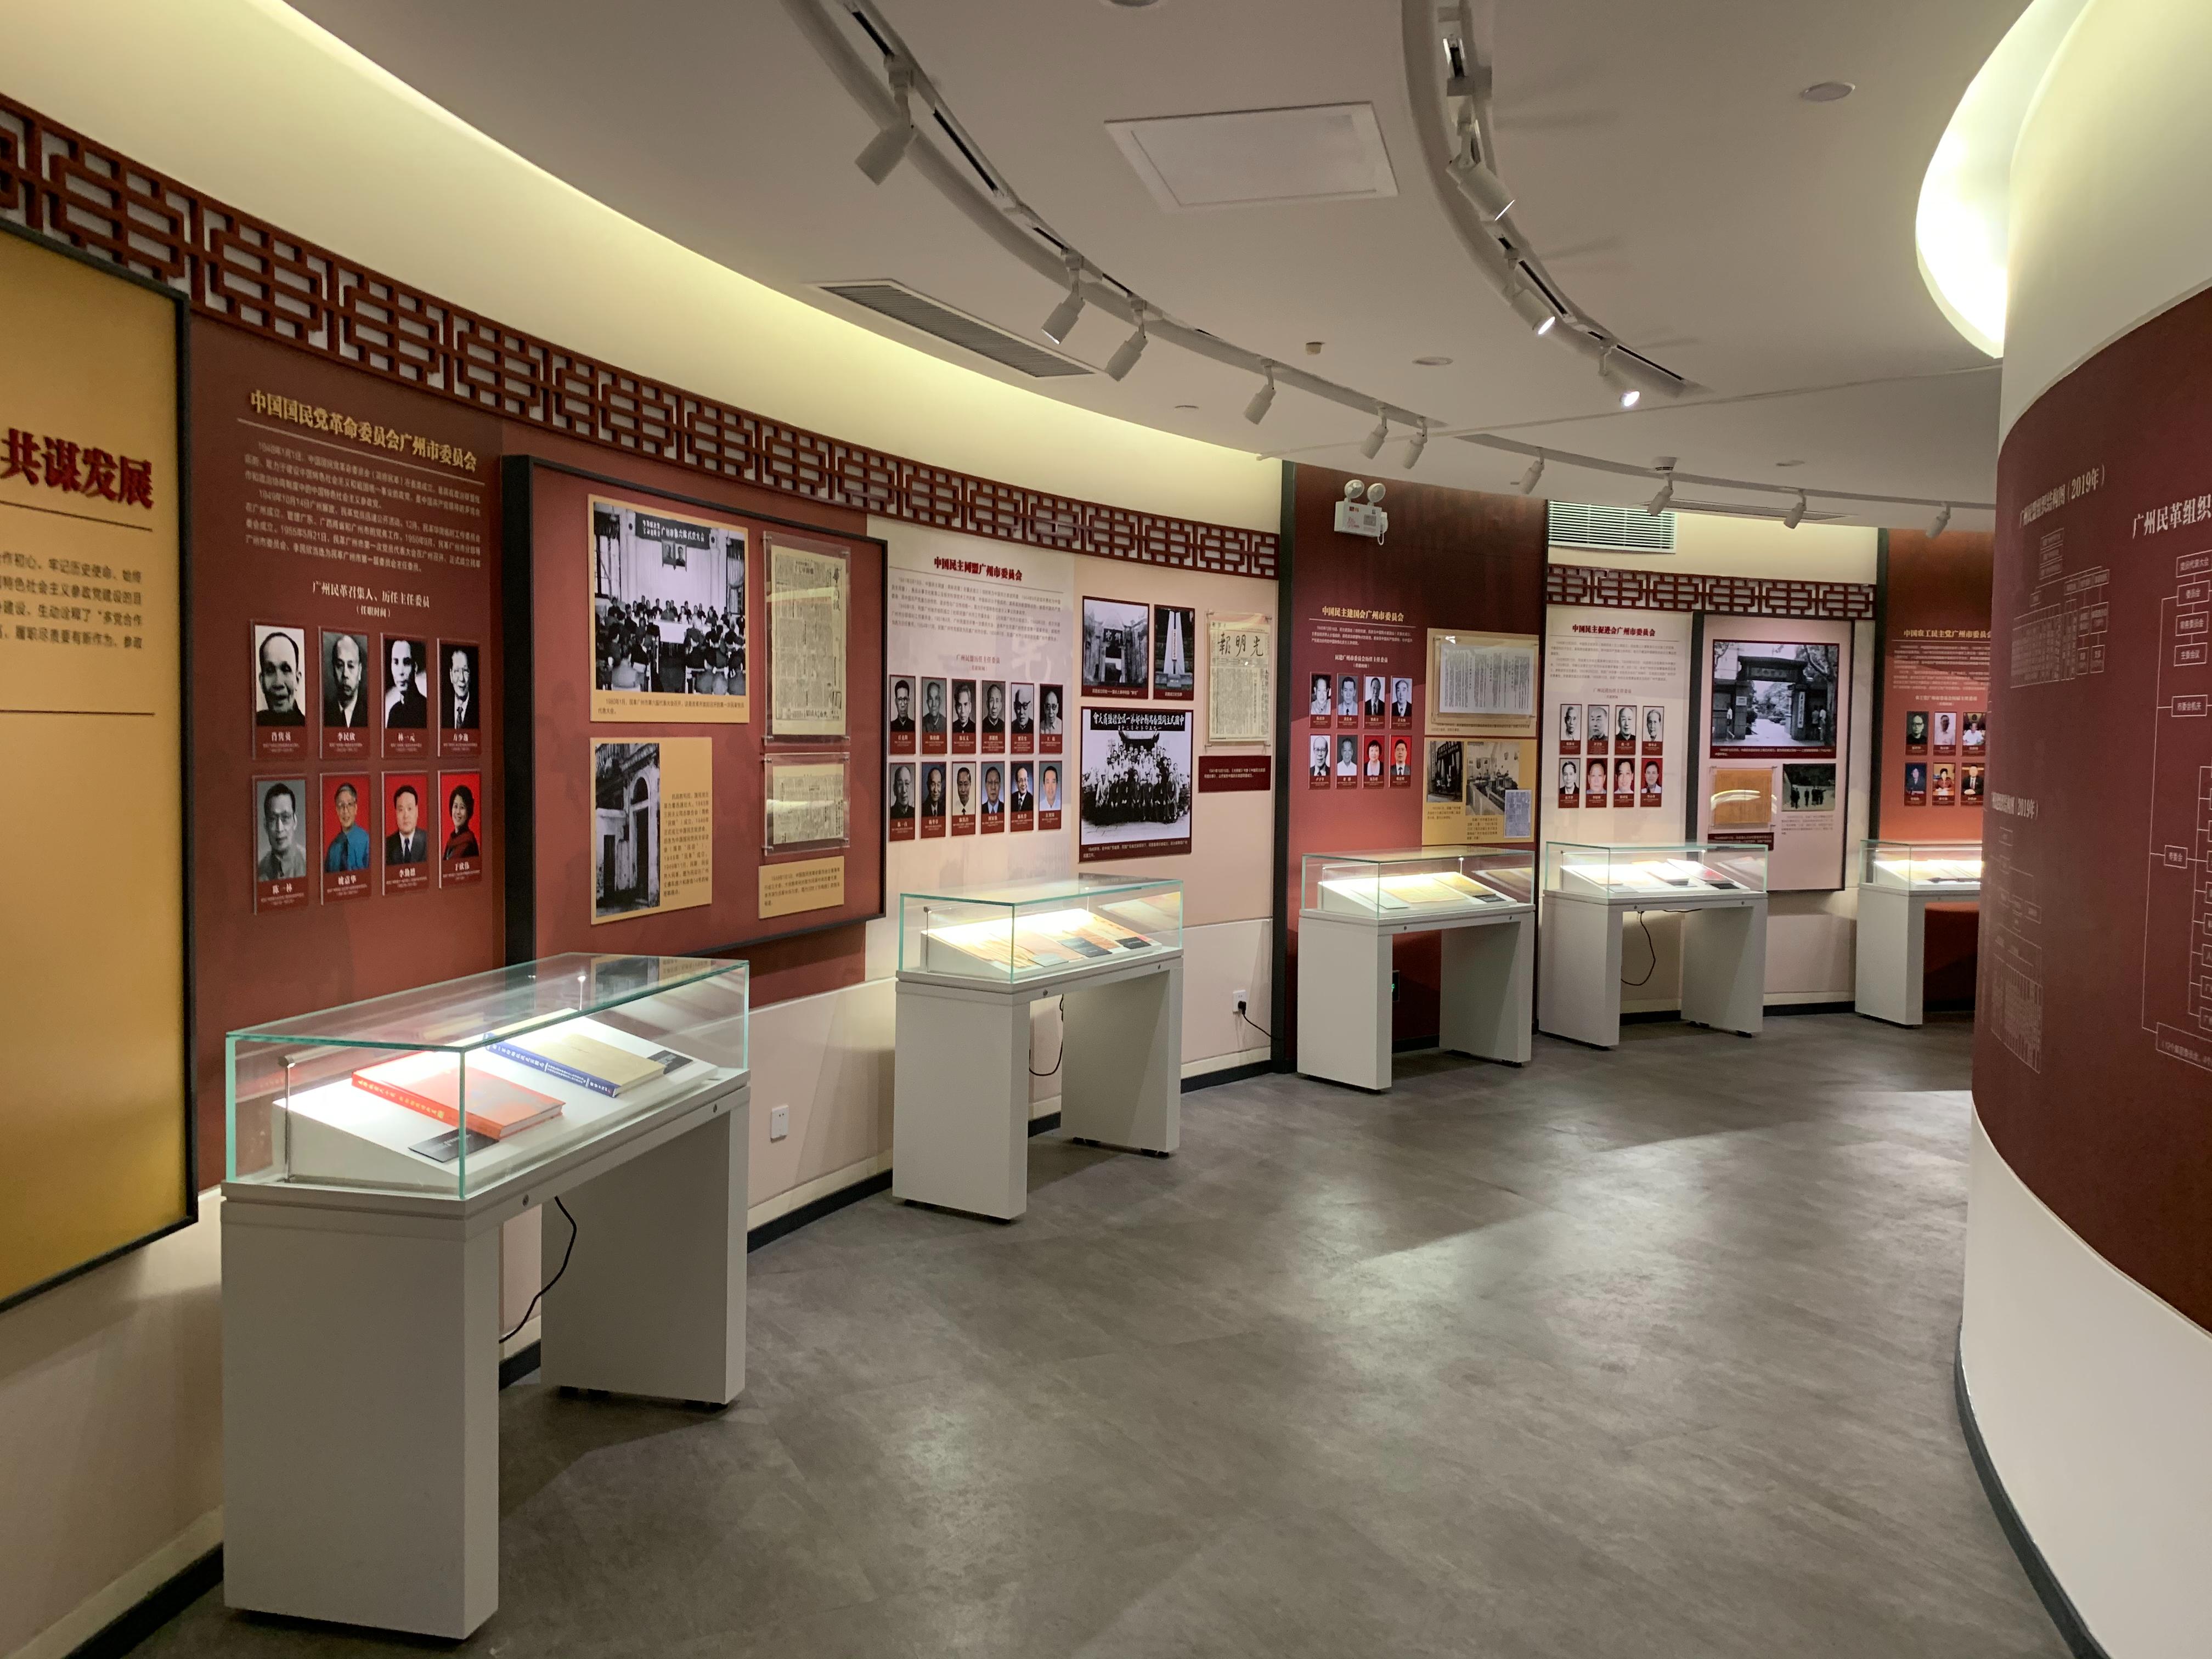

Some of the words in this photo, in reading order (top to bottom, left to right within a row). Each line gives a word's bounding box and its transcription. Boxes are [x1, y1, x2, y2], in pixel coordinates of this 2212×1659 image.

[251, 389, 477, 472] 中国国民党革命委员会广州市委员会
[0, 428, 154, 510] 共谋发展
[2132, 493, 2211, 539] 广州民革组织
[934, 556, 1023, 582] 中国民主同盟广州市委员会
[1322, 606, 1404, 622] 中国民主建国会广州市委员会
